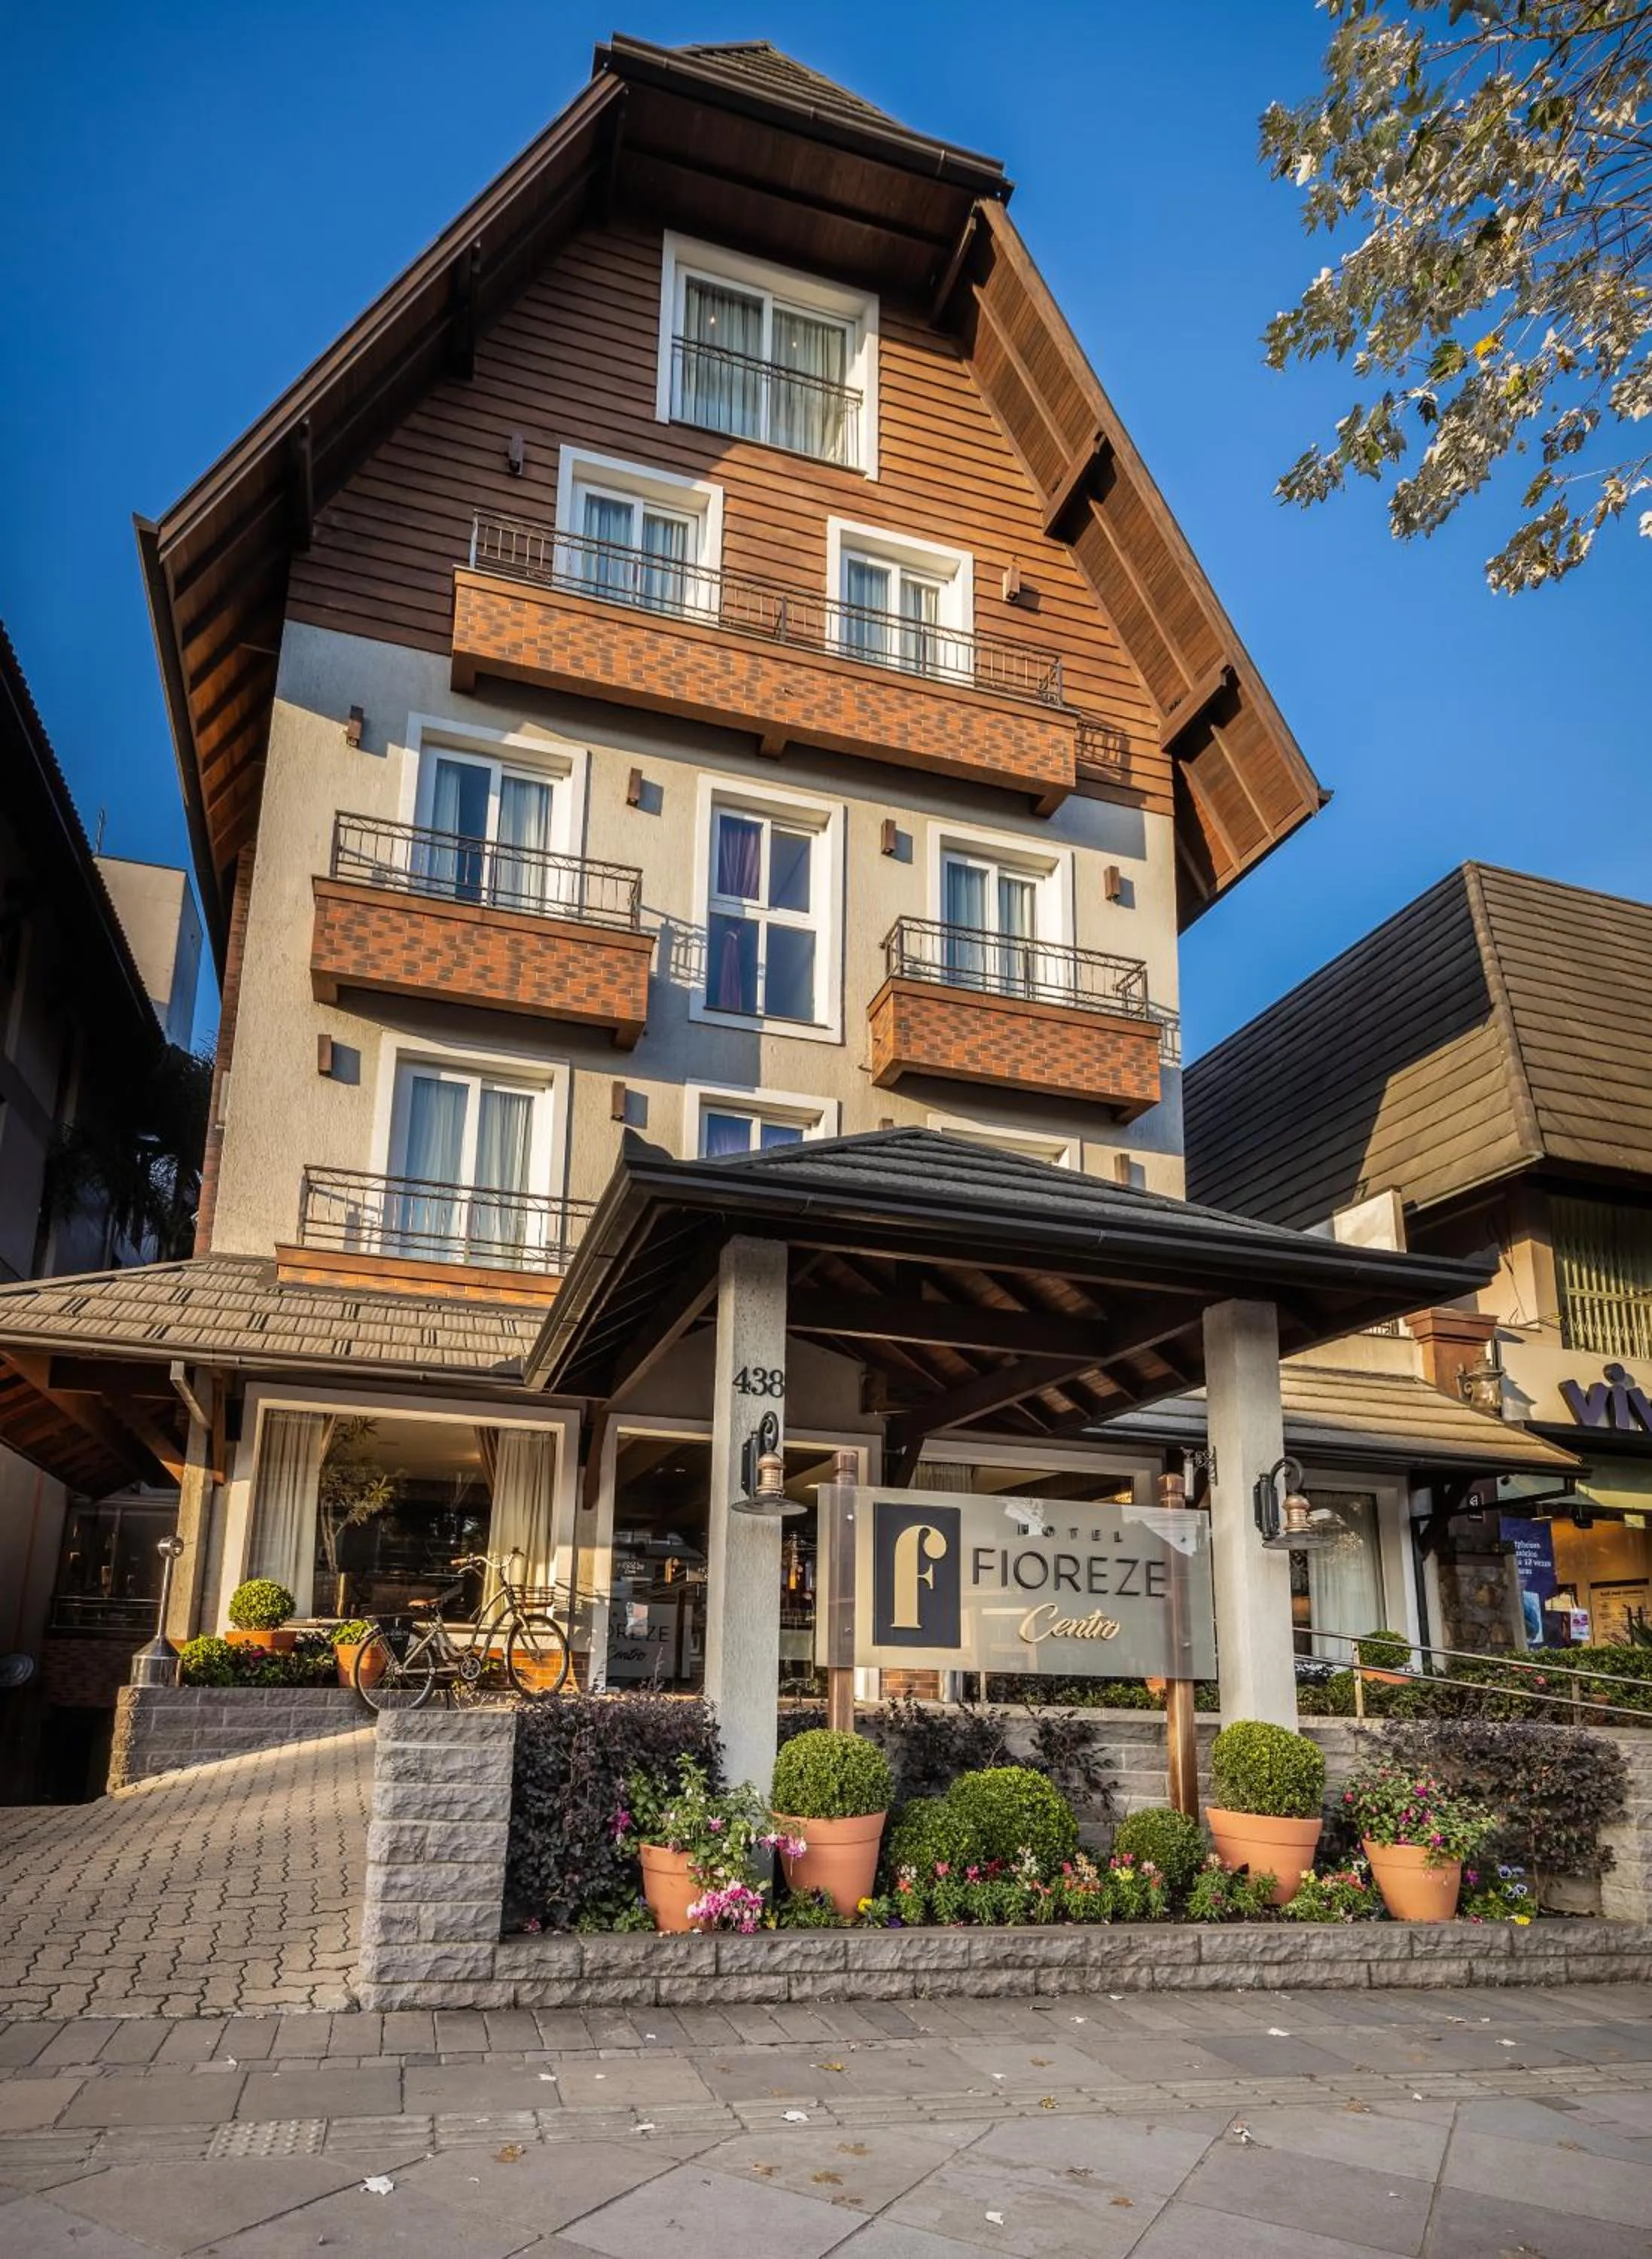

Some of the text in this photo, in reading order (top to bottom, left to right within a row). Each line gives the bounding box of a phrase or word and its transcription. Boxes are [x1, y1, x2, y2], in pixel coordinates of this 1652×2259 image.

[732, 1367, 785, 1398] 438
[1017, 1523, 1123, 1543] HOTEL
[972, 1547, 1166, 1597] FIOREZE
[1018, 1603, 1120, 1644] Centro
